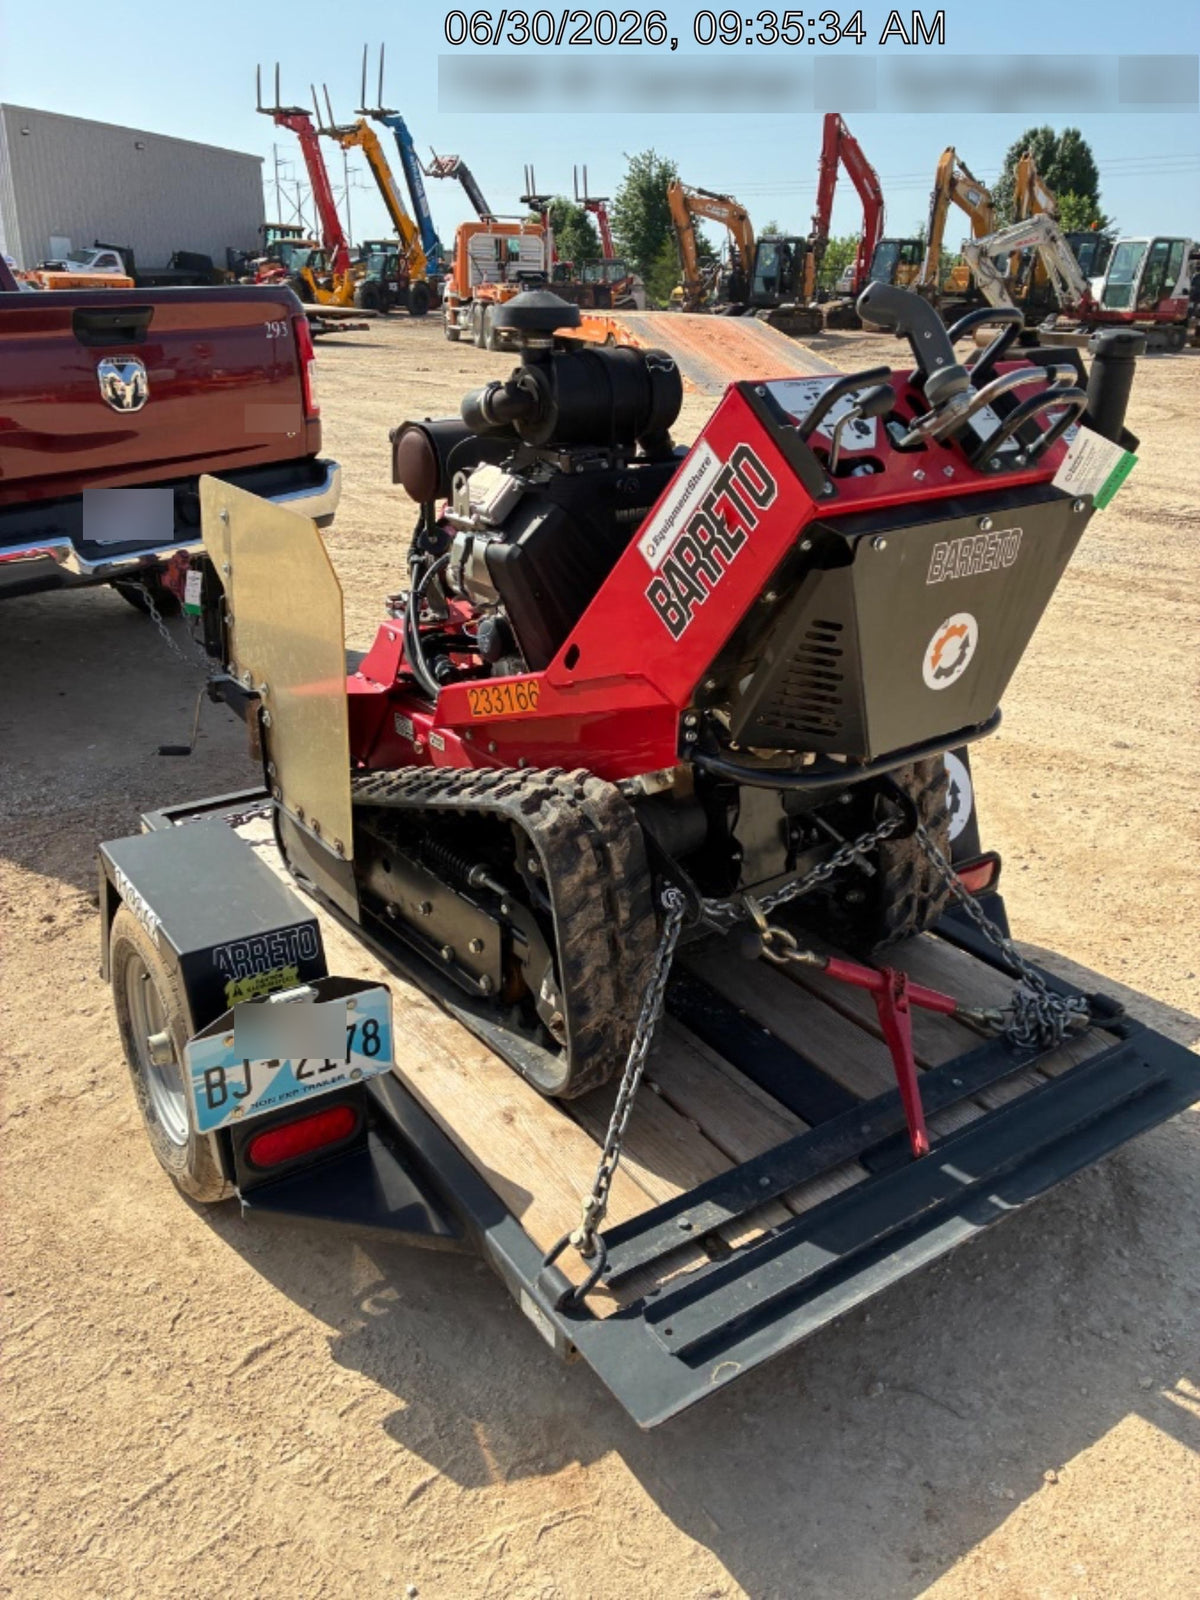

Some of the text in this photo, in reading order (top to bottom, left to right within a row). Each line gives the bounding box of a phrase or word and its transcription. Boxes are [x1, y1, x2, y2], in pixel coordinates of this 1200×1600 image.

[265, 321, 289, 338] 293
[652, 456, 712, 547] EquipmentShare
[644, 442, 778, 642] BARRETO
[926, 527, 1024, 586] BARRETO
[469, 681, 539, 716] 233166
[303, 1073, 346, 1092] TRAILER
